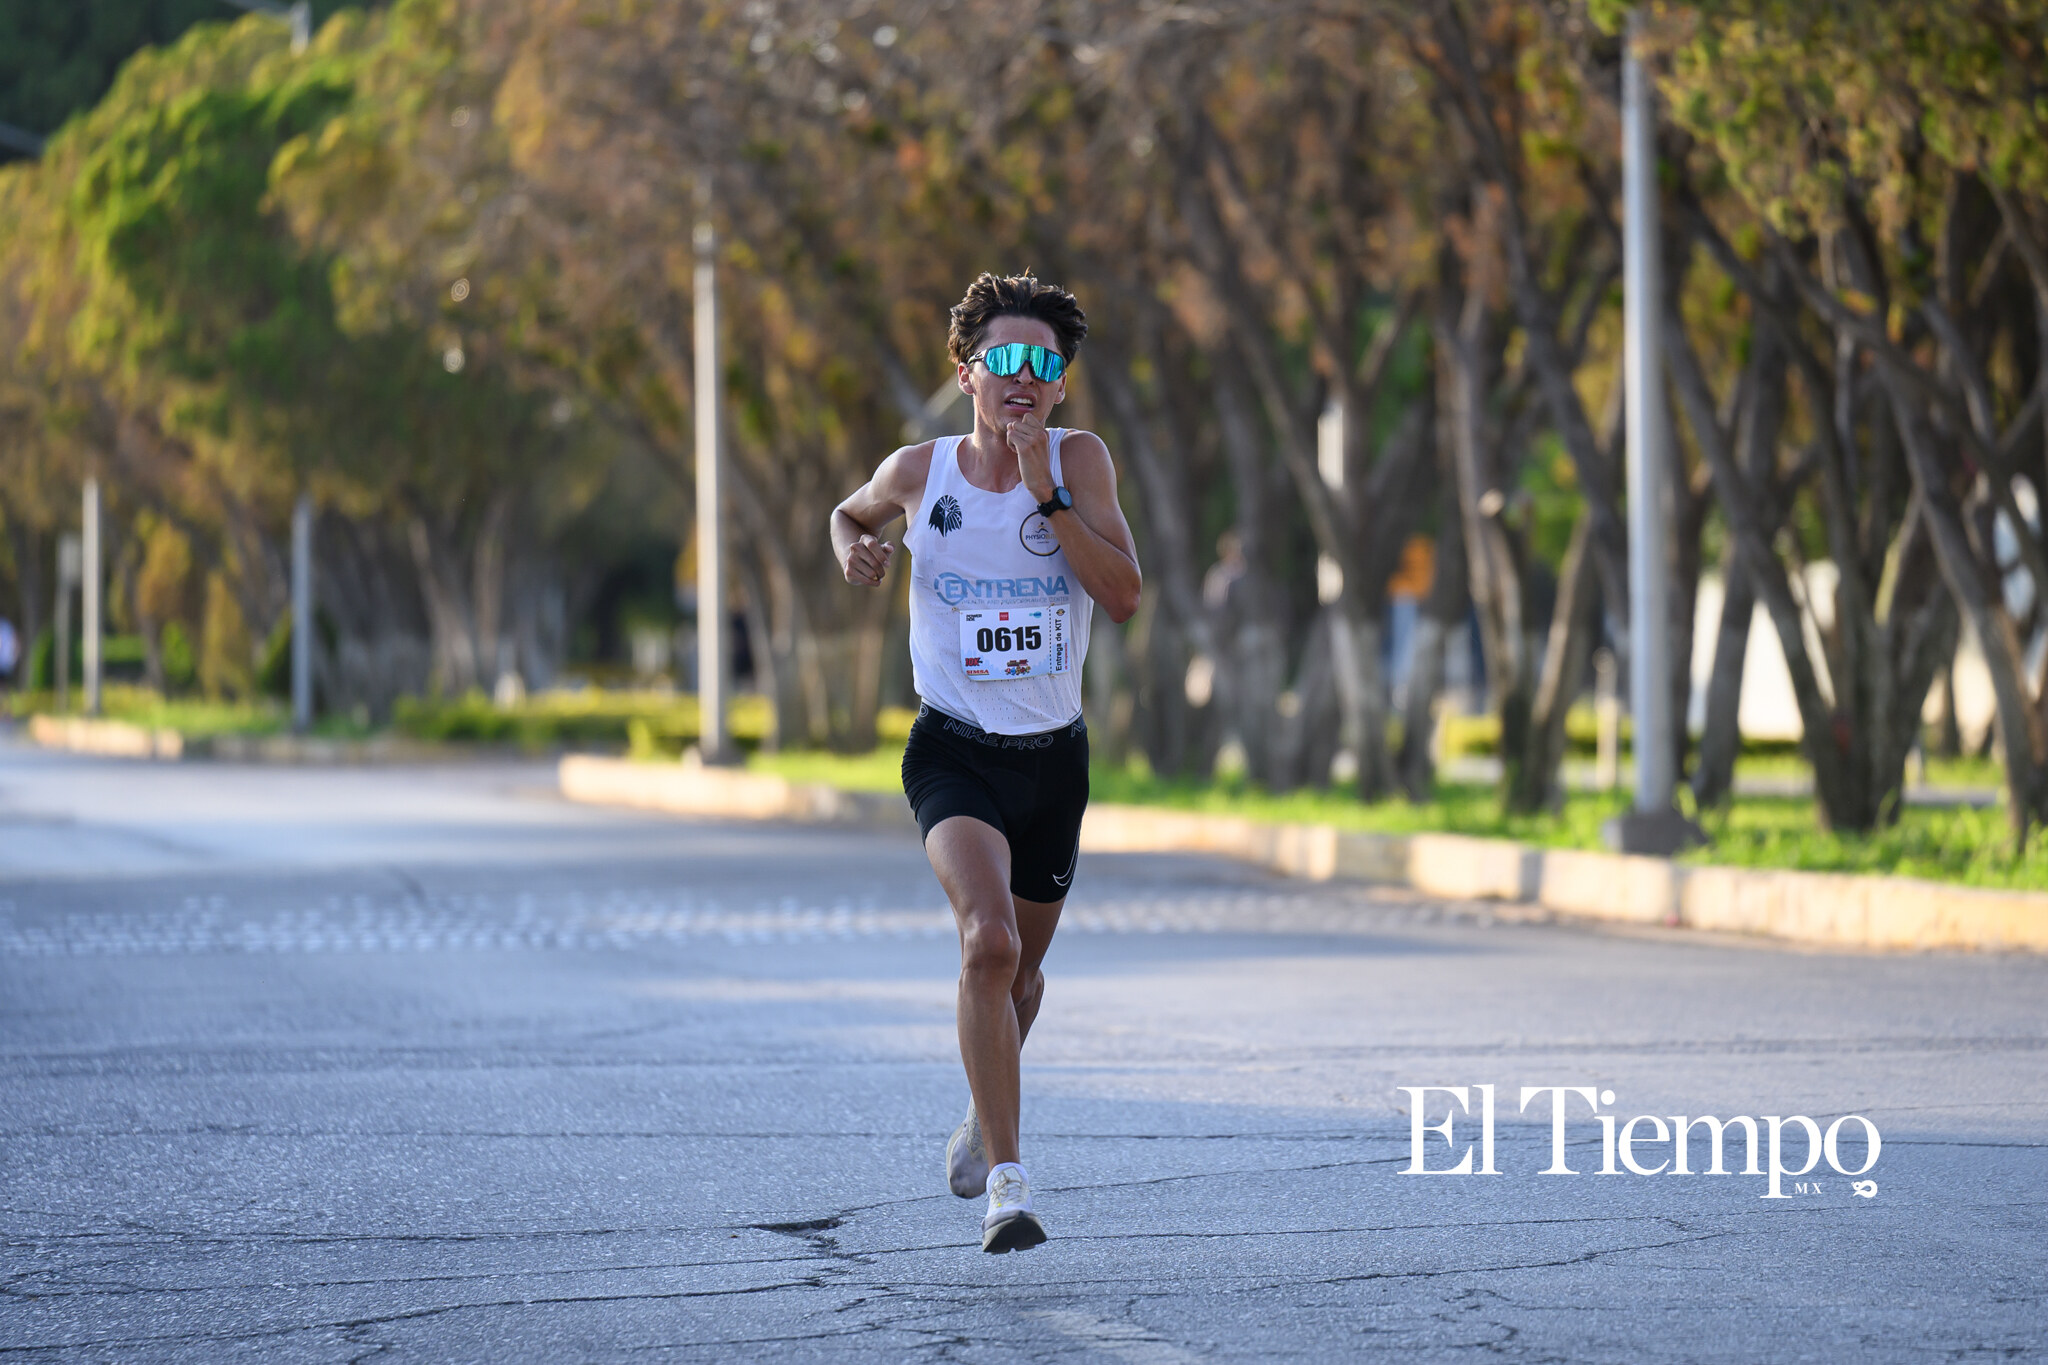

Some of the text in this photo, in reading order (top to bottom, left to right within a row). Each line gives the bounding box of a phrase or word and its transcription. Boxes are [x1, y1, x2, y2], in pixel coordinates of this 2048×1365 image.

[944, 575, 1070, 599] ENTRENA
[977, 625, 1041, 653] 0615
[1055, 633, 1062, 641] de
[1055, 643, 1063, 671] Entrega
[943, 717, 1054, 750] NIKE PRO
